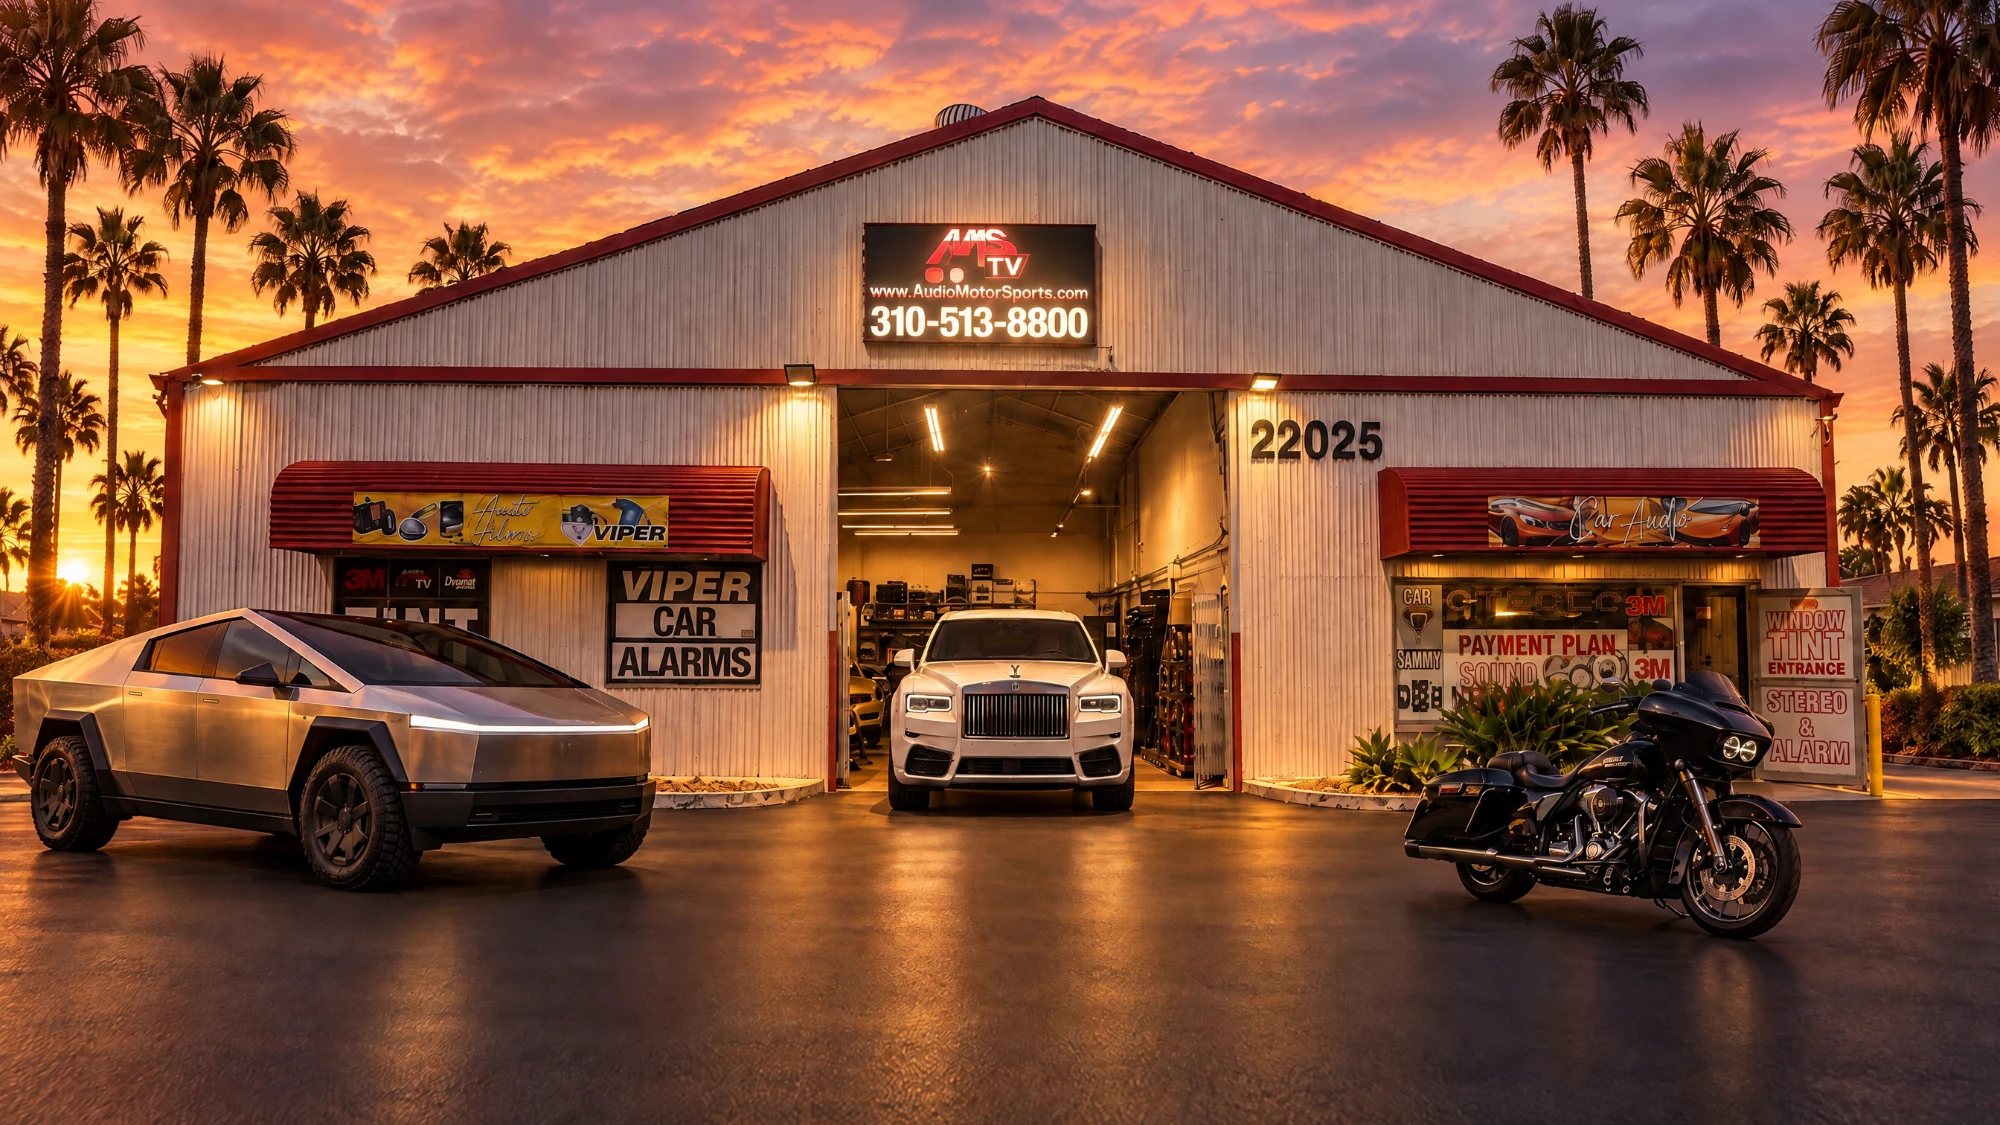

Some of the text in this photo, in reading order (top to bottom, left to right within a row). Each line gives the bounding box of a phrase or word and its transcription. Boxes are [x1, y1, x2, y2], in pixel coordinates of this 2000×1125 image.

[987, 257, 1023, 276] TV
[870, 283, 1089, 303] www.AudioMotorSports.com
[870, 305, 1089, 339] 310-513-8800
[1251, 419, 1383, 461] 22025
[1568, 495, 1692, 544] Car Audio
[594, 524, 667, 542] VIPER
[344, 568, 385, 591] 3M
[415, 579, 432, 589] TV
[622, 570, 751, 602] VIPER
[1403, 588, 1432, 605] CAR
[1626, 595, 1666, 617] 3M
[653, 606, 717, 637] CAR
[1766, 610, 1845, 631] WINDOW
[1458, 634, 1616, 656] PAYMENT PLAN
[1767, 631, 1845, 661] TINT
[617, 646, 752, 678] ALARMS
[1396, 650, 1442, 670] SAMMY
[1633, 658, 1671, 680] 3M
[1768, 662, 1846, 676] ENTRANCE
[1459, 661, 1538, 688] SOUND
[1766, 690, 1848, 714] STEREO
[1799, 717, 1815, 738] &
[1770, 738, 1850, 765] ALARM
